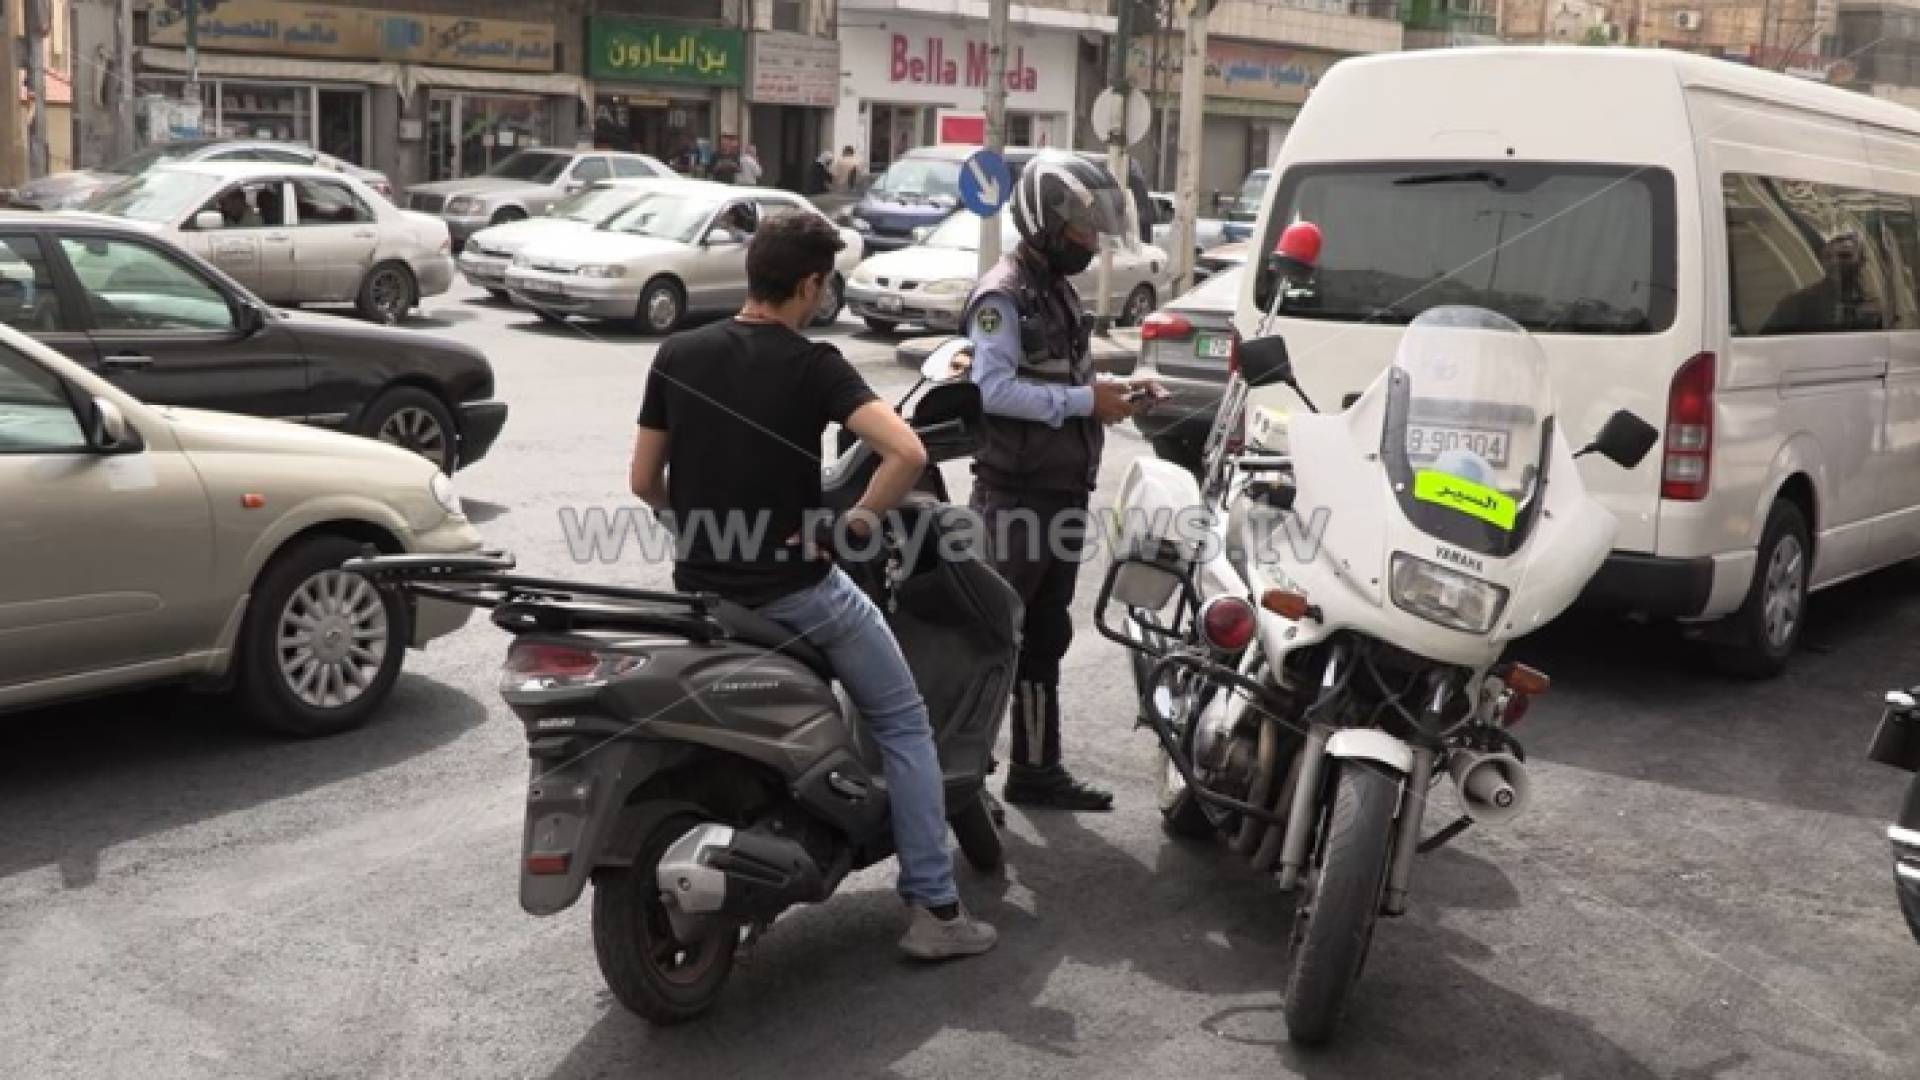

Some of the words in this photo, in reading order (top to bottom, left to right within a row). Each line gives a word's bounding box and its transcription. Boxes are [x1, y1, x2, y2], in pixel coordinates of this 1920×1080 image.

[609, 33, 694, 73] البارون
[698, 46, 728, 74] بن
[890, 34, 957, 85] Bella
[967, 41, 1036, 90] Mda
[1436, 486, 1497, 511] السير
[1436, 545, 1483, 572] YAMAHA
